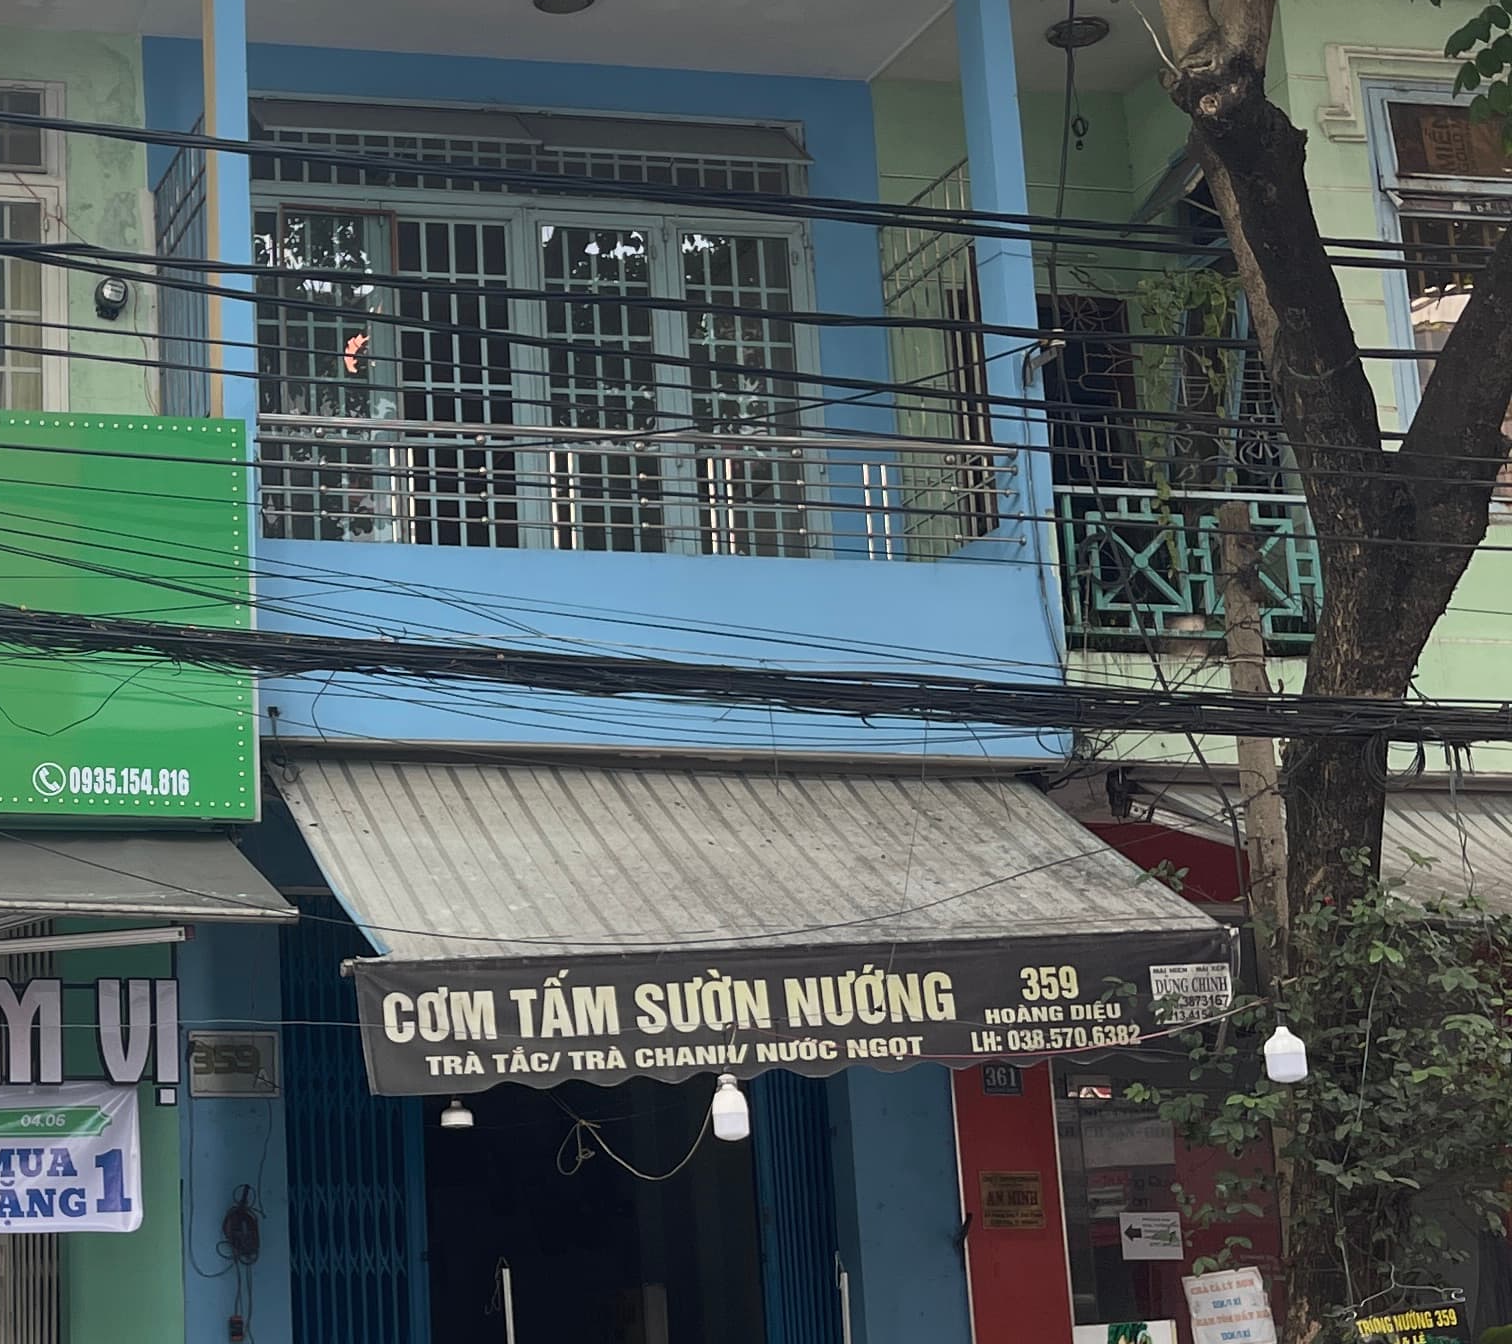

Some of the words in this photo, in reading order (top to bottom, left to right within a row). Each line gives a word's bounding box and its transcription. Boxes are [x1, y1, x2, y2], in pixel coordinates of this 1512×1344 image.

[69, 766, 190, 796] 0935.154.816
[1019, 965, 1081, 1001] 359
[382, 986, 498, 1044] CƠM
[509, 969, 621, 1039] TẤM
[634, 968, 773, 1035] SƯỜN
[783, 963, 958, 1028] NƯỚNG
[984, 1003, 1065, 1025] HOÀNG
[1071, 1000, 1122, 1023] DIỆU
[96, 977, 181, 1106] VỊ
[970, 1031, 1003, 1054] LH:
[1007, 1024, 1141, 1052] 038.570.6382
[425, 1051, 486, 1076] TRÀ
[568, 1046, 628, 1071] TRÀ
[756, 1037, 839, 1063] NƯỚC
[846, 1035, 925, 1061] NGỌT
[985, 1067, 1018, 1087] 361
[19, 1113, 67, 1127] 04.06
[94, 1148, 133, 1214] 1
[1434, 1308, 1458, 1327] 359
